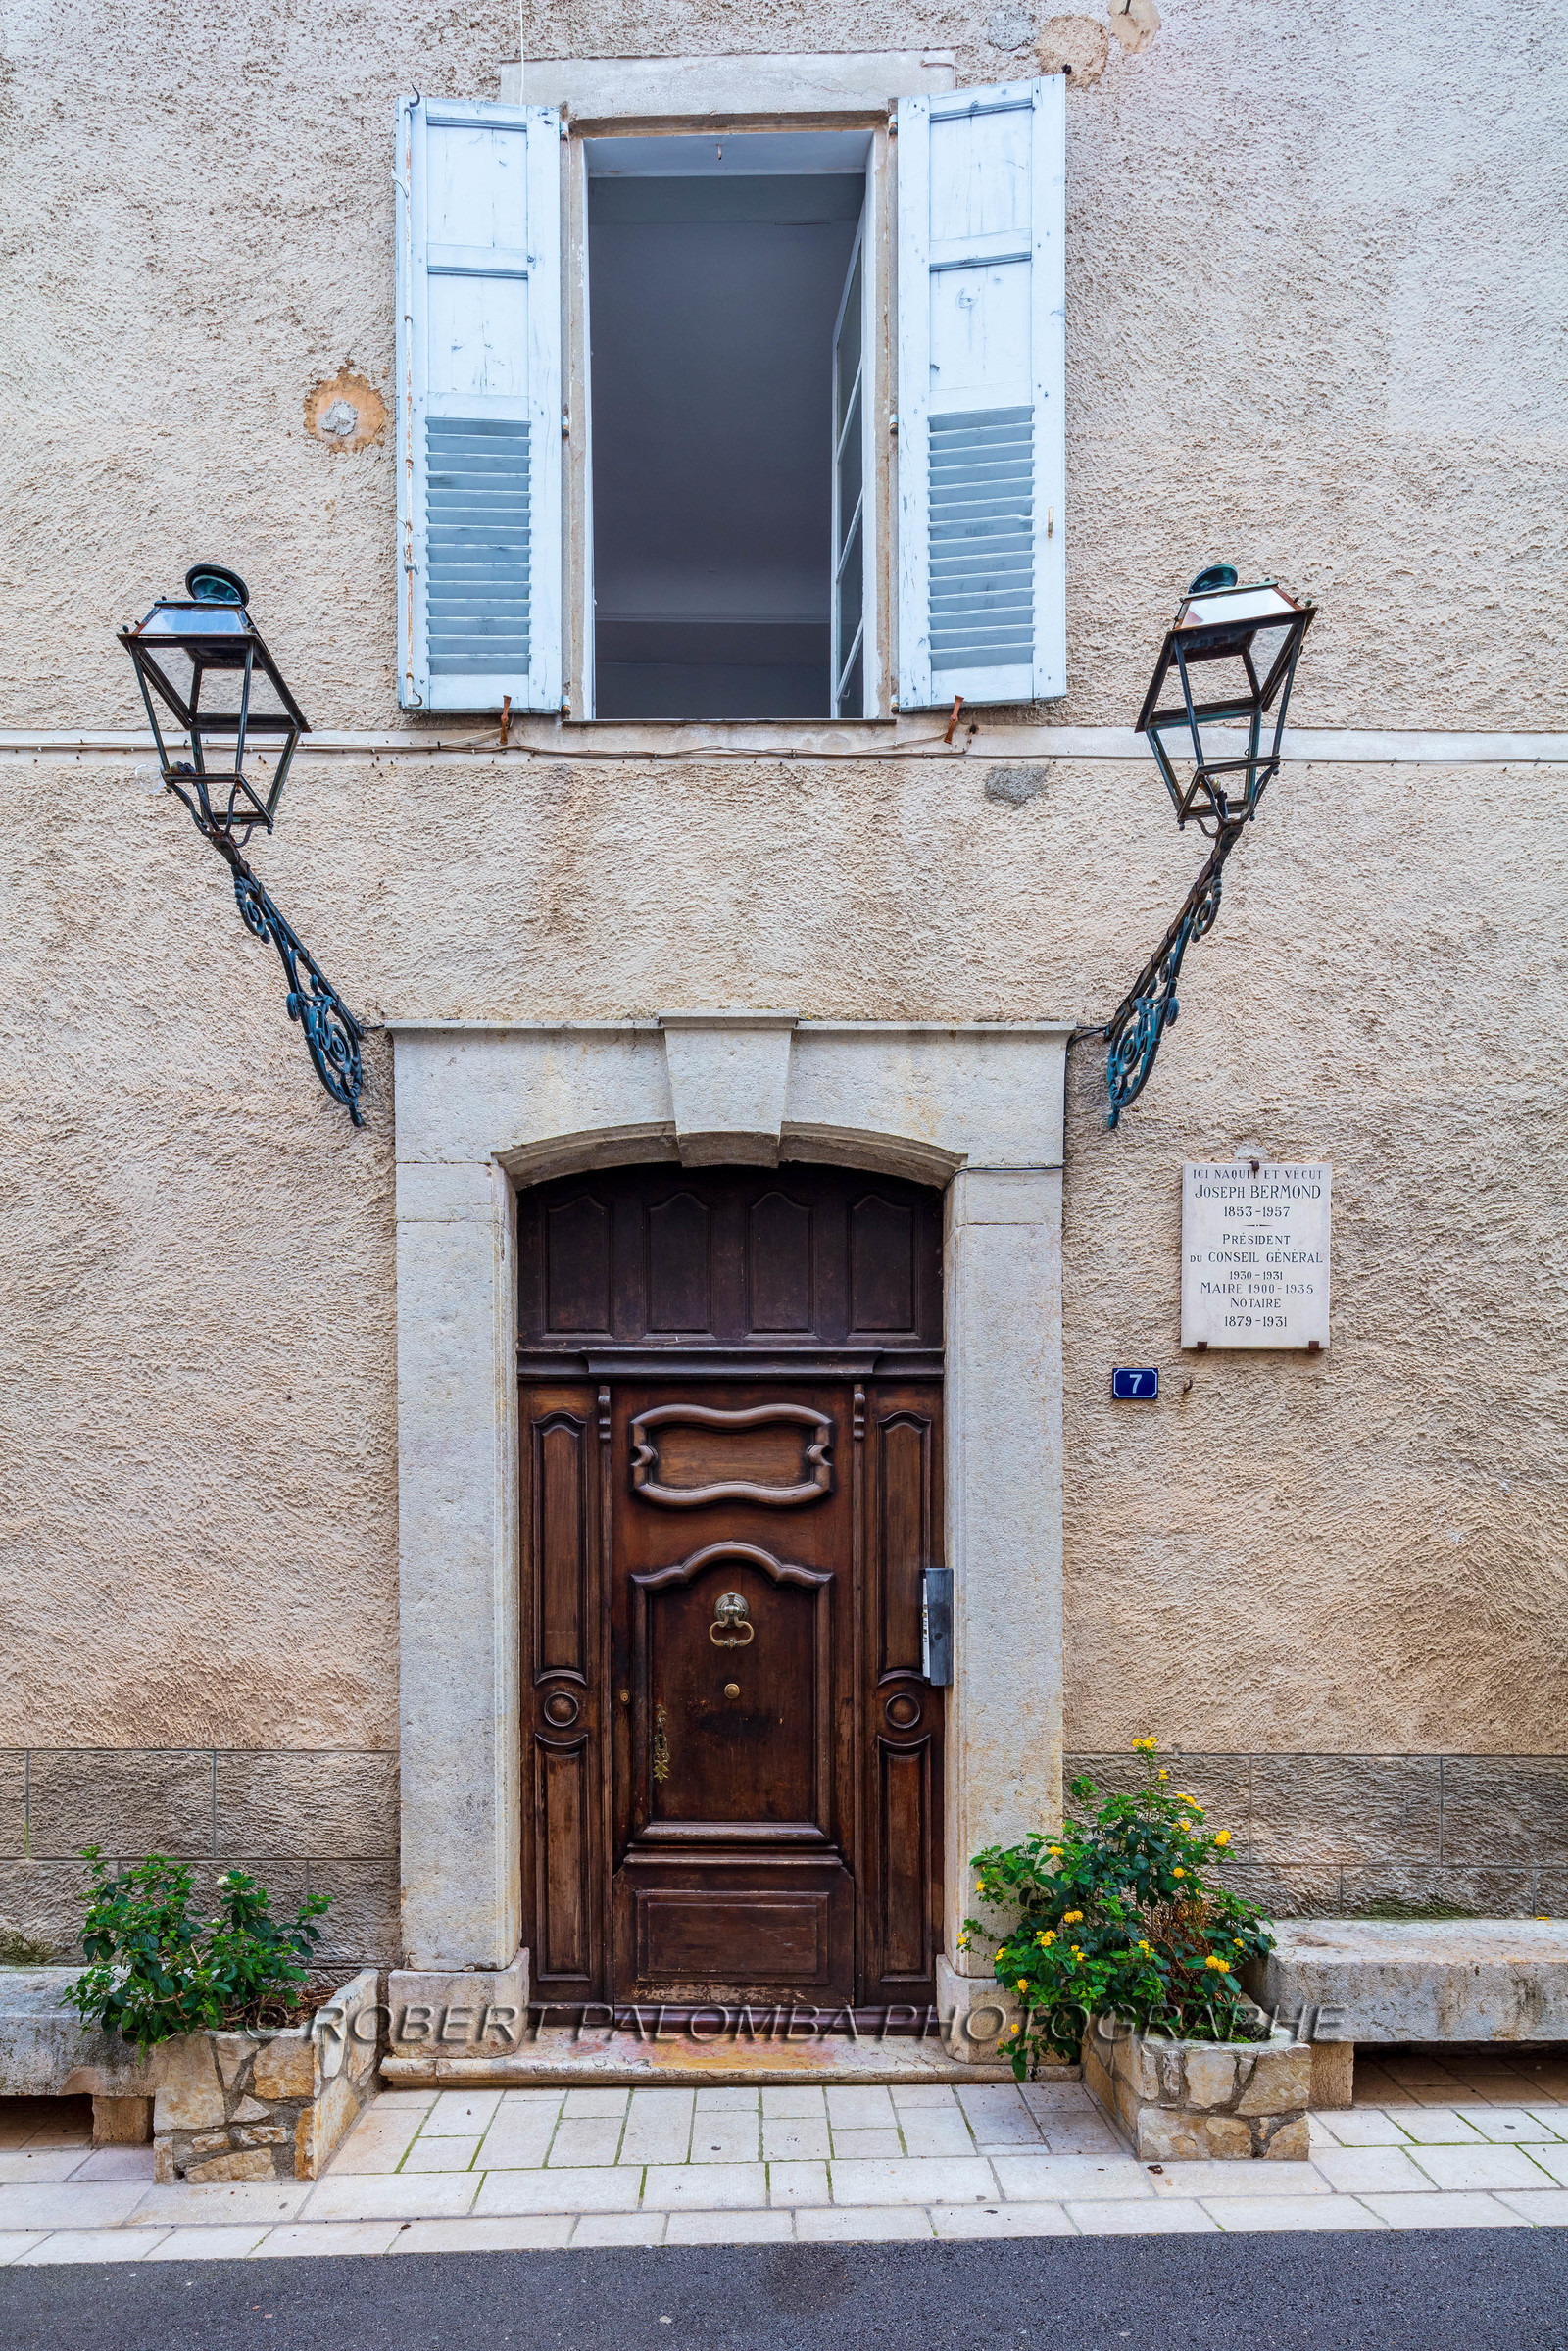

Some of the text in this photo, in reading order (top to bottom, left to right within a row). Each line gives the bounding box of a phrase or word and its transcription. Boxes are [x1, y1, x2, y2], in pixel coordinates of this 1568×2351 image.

[1193, 1167, 1323, 1180] ICI NAQUIT ET VÉCUT
[1195, 1184, 1321, 1199] JOSEPH BERMOND
[1222, 1232, 1291, 1245] PRÉSIDENT
[1190, 1249, 1323, 1263] DU CONSEIL GÉNÉRAL
[1200, 1282, 1243, 1294] MAIRE
[1230, 1298, 1281, 1308] NOTAIRE
[1129, 1374, 1143, 1394] 7
